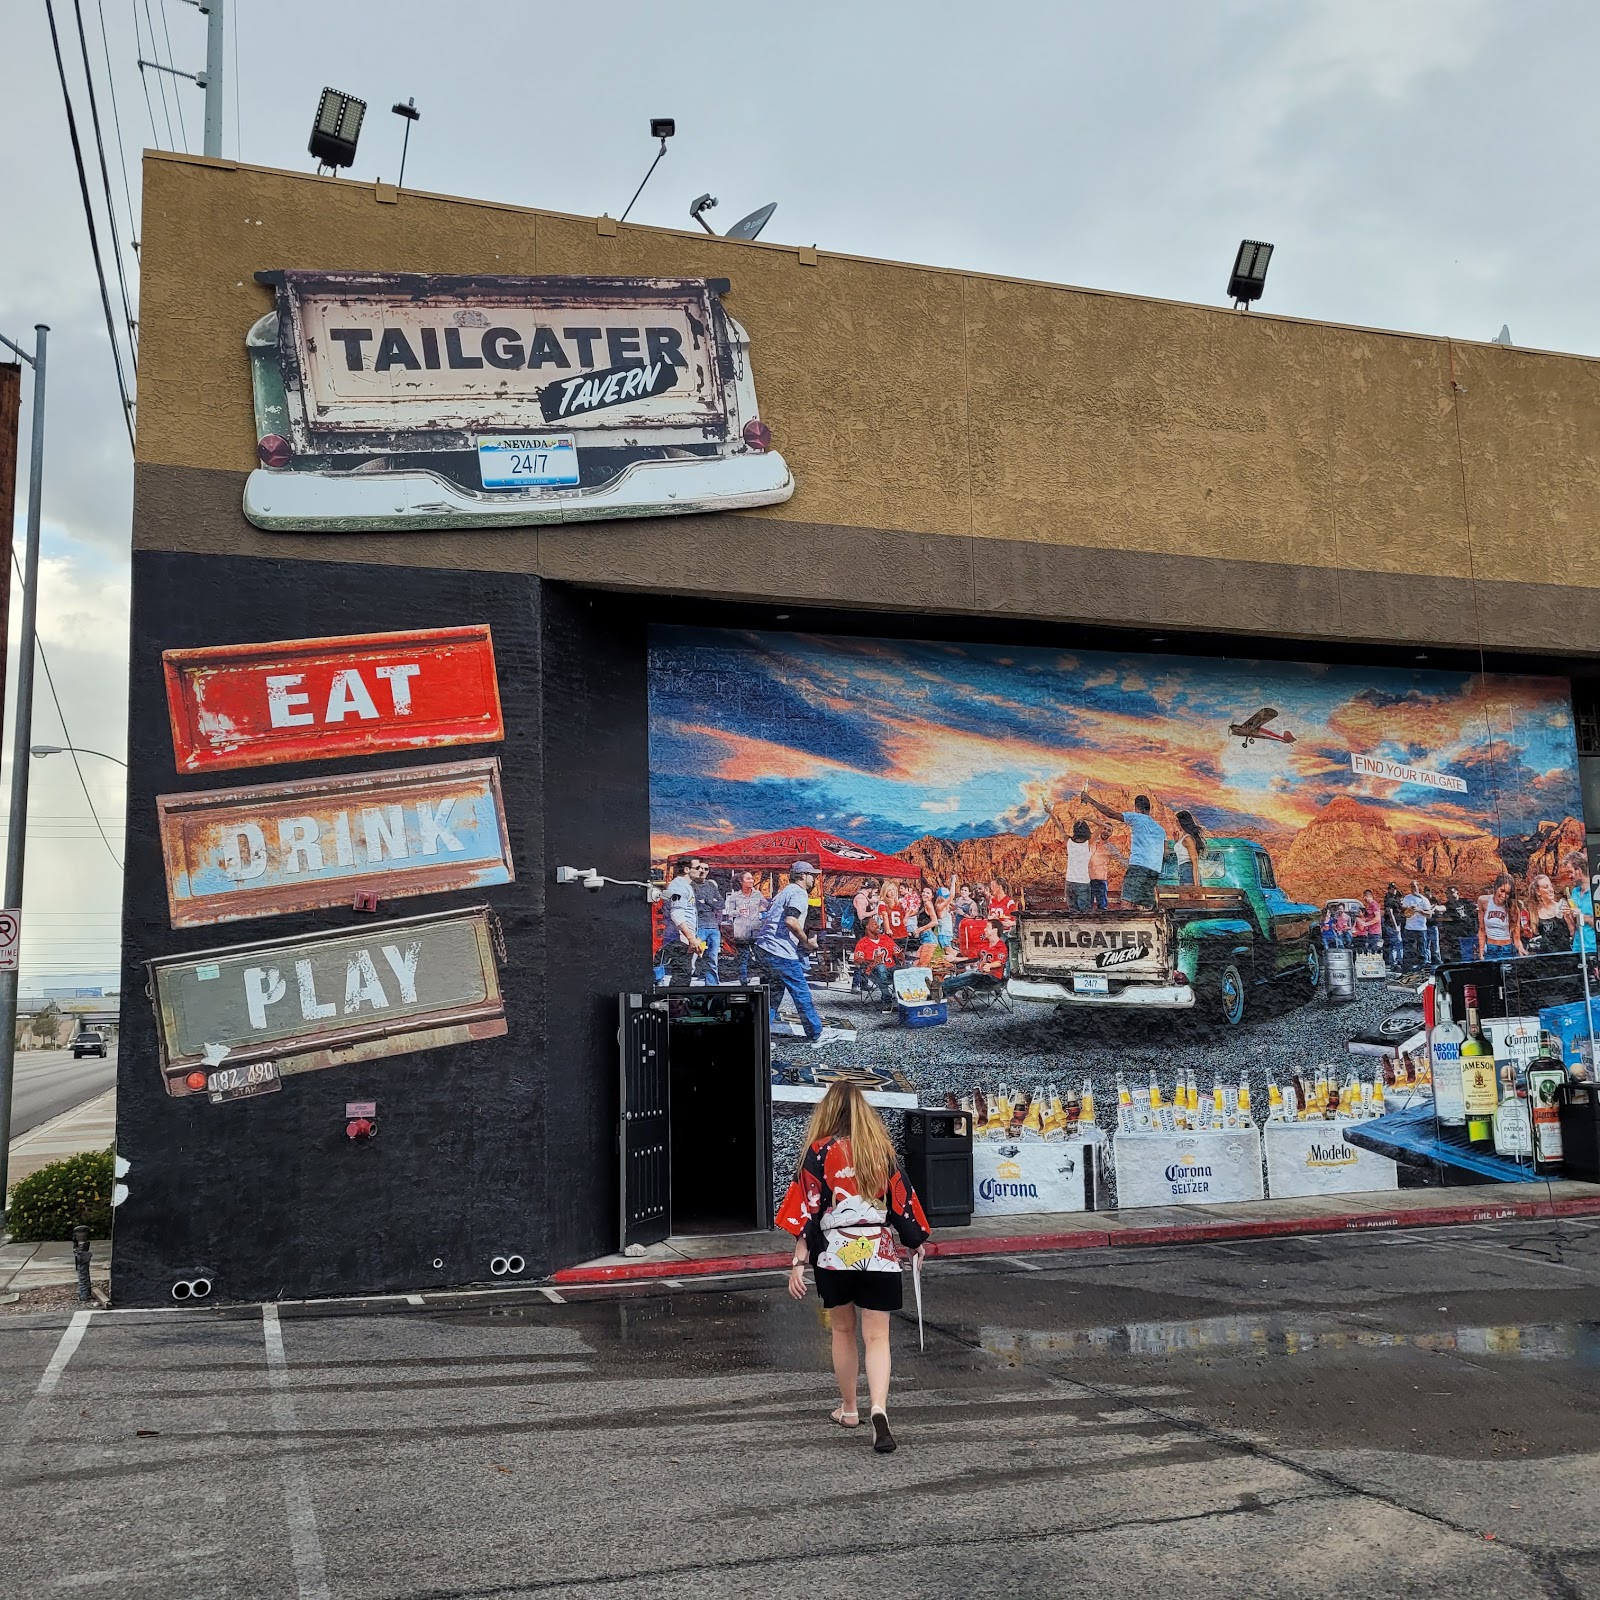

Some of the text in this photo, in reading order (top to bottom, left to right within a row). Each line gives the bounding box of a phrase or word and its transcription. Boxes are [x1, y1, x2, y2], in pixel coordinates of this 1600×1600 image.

[329, 326, 689, 371] TAILGATER
[558, 361, 663, 416] TAVERN
[503, 439, 549, 449] NEVADA
[510, 454, 549, 474] 24/7
[265, 663, 421, 728] EAT
[1355, 756, 1463, 791] FIND YOUR TAILGATE
[220, 797, 466, 882] DRINK
[1030, 930, 1154, 949] TAILGATER
[1101, 945, 1144, 967] TAVERN
[243, 940, 423, 1030] PLAY
[1084, 979, 1098, 988] 24/7
[1433, 1043, 1460, 1052] ABSOLU
[1504, 1034, 1539, 1049] Corona
[1436, 1052, 1460, 1061] VODK
[1462, 1060, 1494, 1073] JAMESON
[247, 1061, 274, 1085] 490
[232, 1085, 257, 1097] UTAH
[1311, 1143, 1352, 1162] Modelo
[1164, 1164, 1213, 1184] Corona
[979, 1177, 1039, 1203] Corona
[1171, 1182, 1209, 1195] SELTZER
